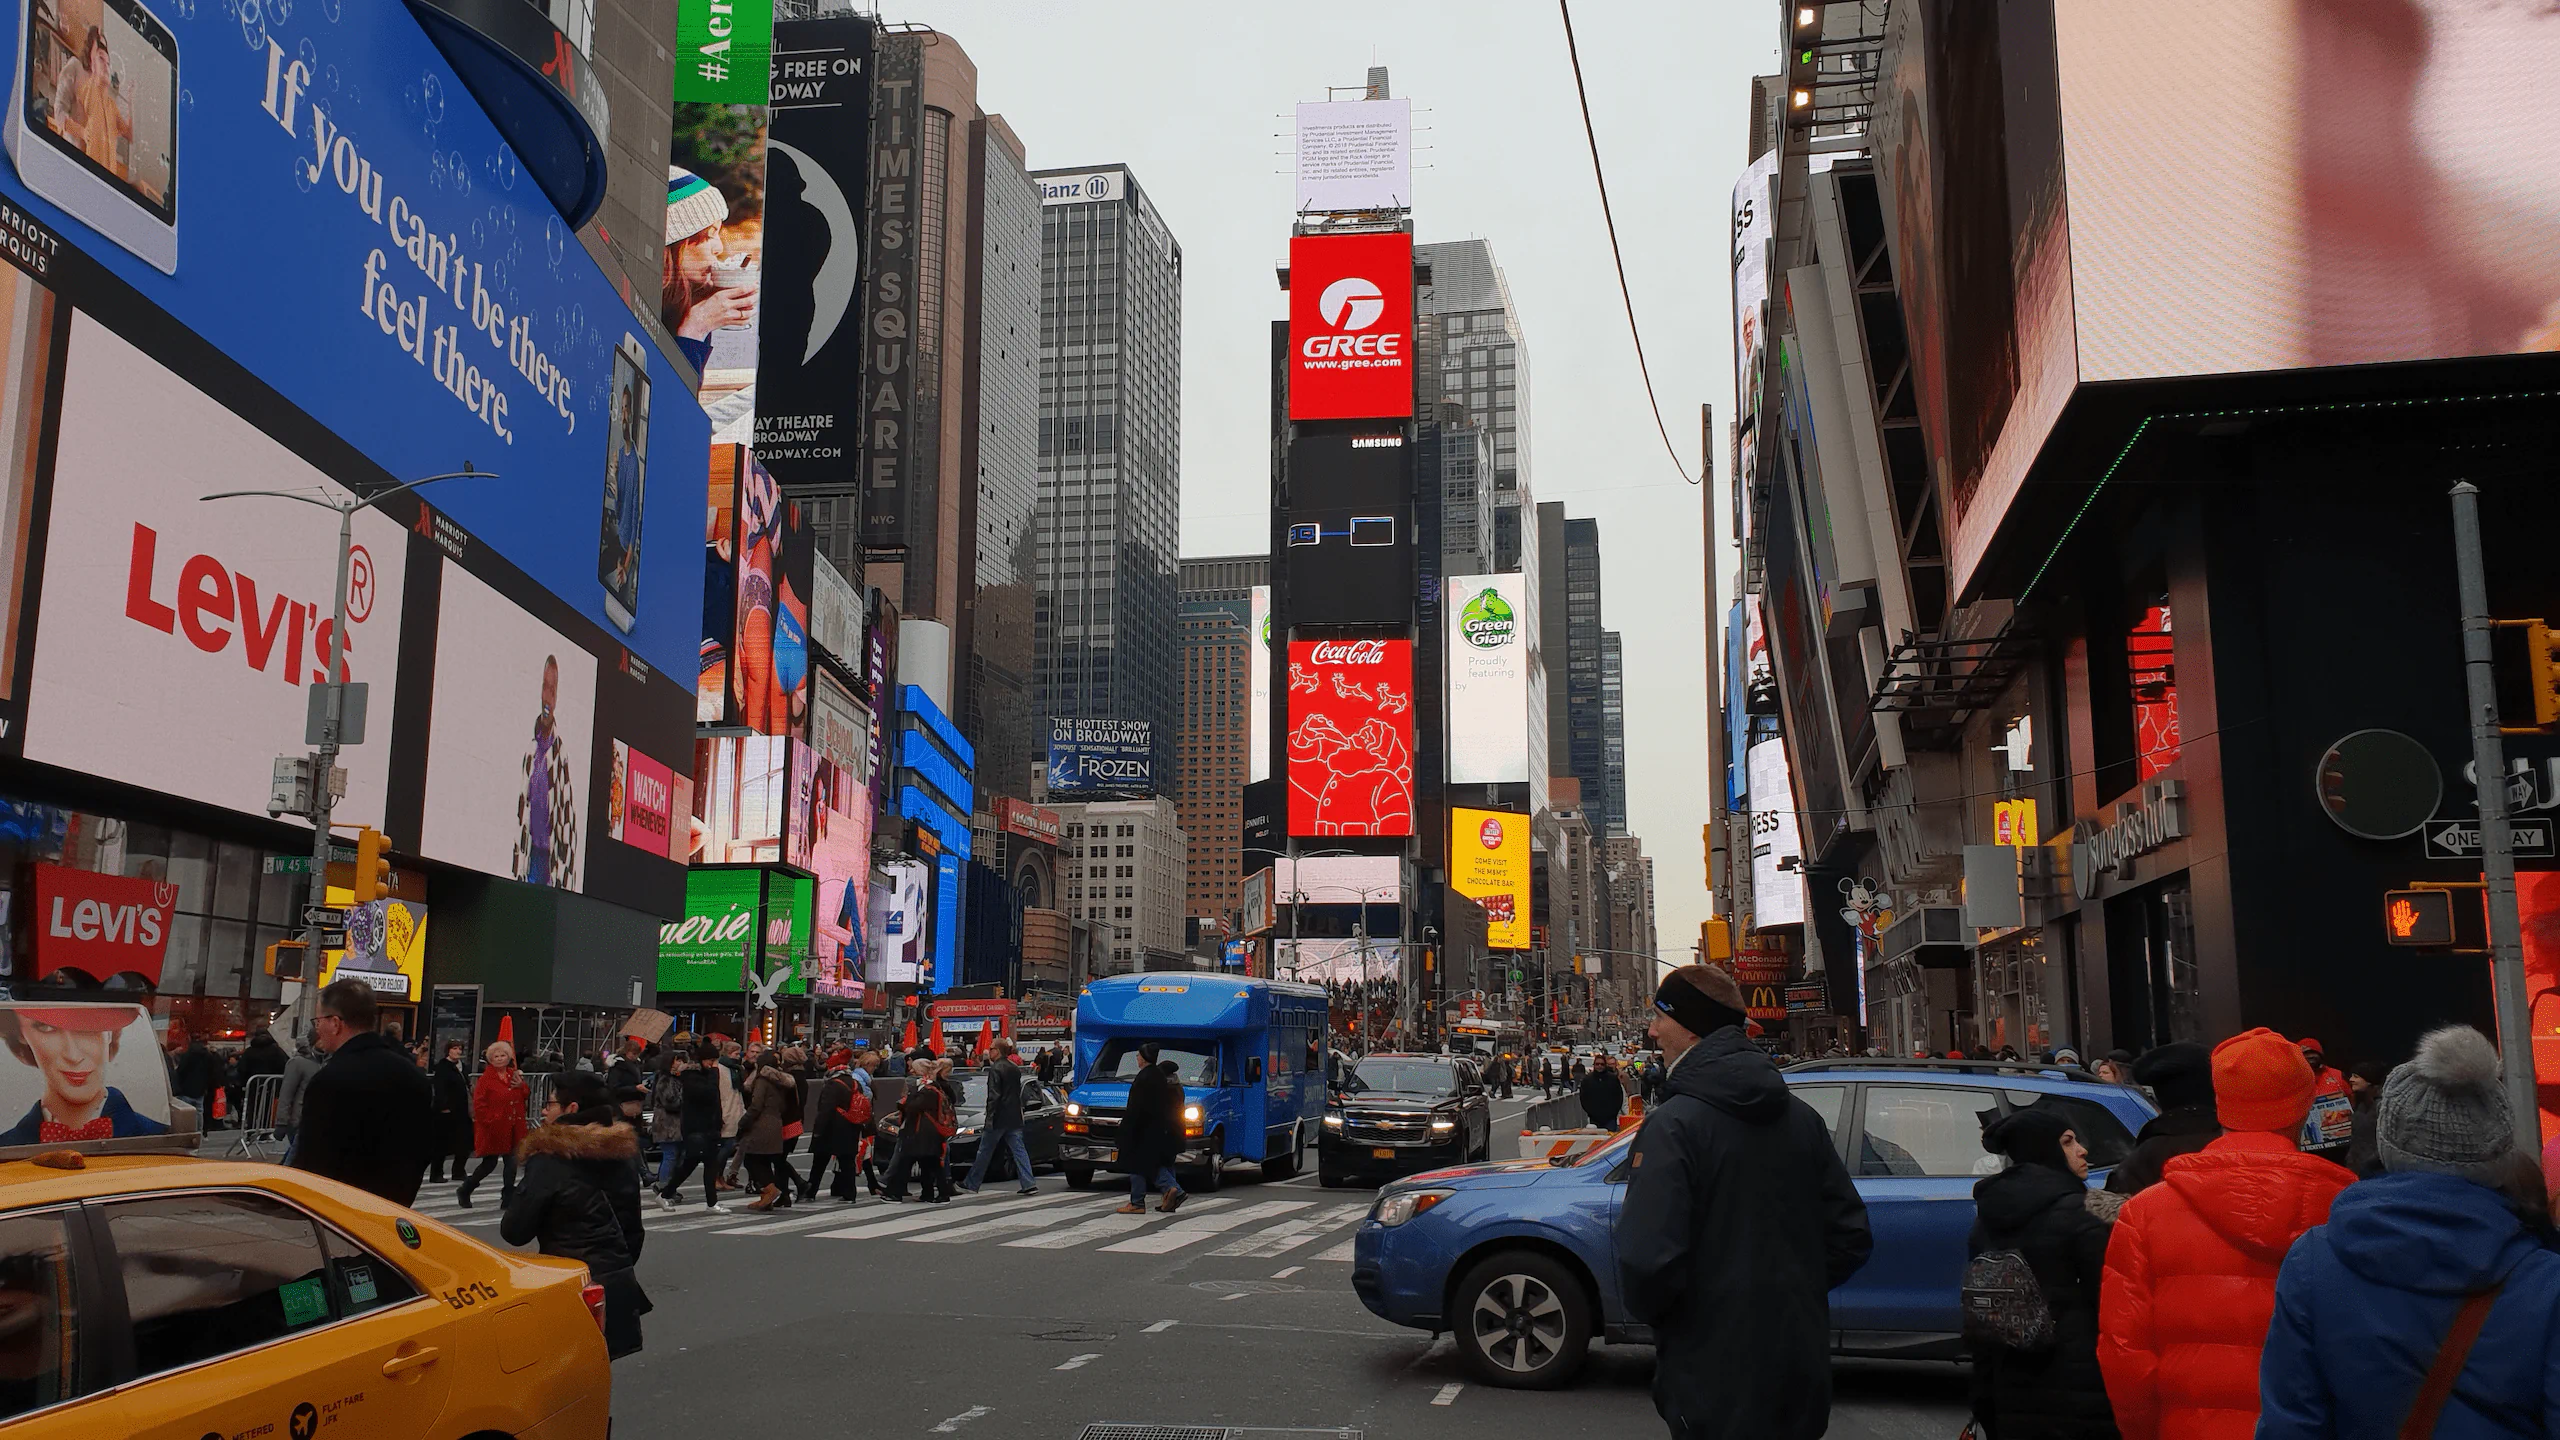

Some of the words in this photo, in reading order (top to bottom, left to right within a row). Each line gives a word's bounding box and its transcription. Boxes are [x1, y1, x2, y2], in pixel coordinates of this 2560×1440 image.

[784, 60, 827, 79] FREE
[832, 58, 862, 75] ON
[878, 79, 914, 250] TIMES
[260, 34, 311, 140] If
[309, 103, 383, 225] you
[389, 195, 468, 311] can't
[471, 262, 504, 349] be
[510, 315, 575, 436] there,
[361, 248, 427, 366] feel
[433, 325, 513, 446] there.
[1303, 333, 1401, 358] GREE
[1303, 358, 1402, 371] www.gree.com
[871, 272, 907, 489] SQUARE
[777, 414, 834, 429] THEATRE
[1351, 438, 1402, 449] SAMSUNG
[870, 515, 896, 526] NYC
[435, 514, 468, 546] MARRIOTT
[434, 530, 463, 559] MARQUIS
[125, 520, 353, 687] Levi's
[1465, 618, 1514, 632] Green
[1471, 632, 1516, 645] Giant
[1310, 640, 1388, 665] Coca-Cola
[1468, 655, 1508, 667] Proudly
[1468, 668, 1515, 679] featuring
[1054, 718, 1072, 729] THE
[1076, 719, 1118, 730] HOTTEST
[1121, 721, 1150, 731] SNOW
[1053, 729, 1072, 741] ON
[1076, 730, 1152, 744] BROADWAY!
[1078, 755, 1150, 781] FROZEN
[634, 769, 667, 814] WATCH
[2510, 782, 2528, 802] WAY
[2089, 802, 2144, 881] sunglass
[2143, 779, 2182, 848] hut
[2445, 832, 2480, 846] ONE
[2512, 832, 2535, 846] AY
[275, 860, 284, 872] W
[288, 859, 300, 872] 45
[1474, 857, 1492, 865] COME
[1492, 858, 1508, 866] VISIT
[1466, 878, 1500, 886] CHOCOLATE
[50, 896, 162, 947] Levi's
[308, 911, 320, 921] ONE
[326, 914, 339, 922] WAY
[323, 935, 340, 944] WAY
[1017, 1046, 1040, 1055] POLIC
[442, 1280, 499, 1310] 6G16
[322, 1399, 342, 1414] FLAT
[343, 1391, 365, 1407] FARE
[322, 1414, 338, 1427] JFK
